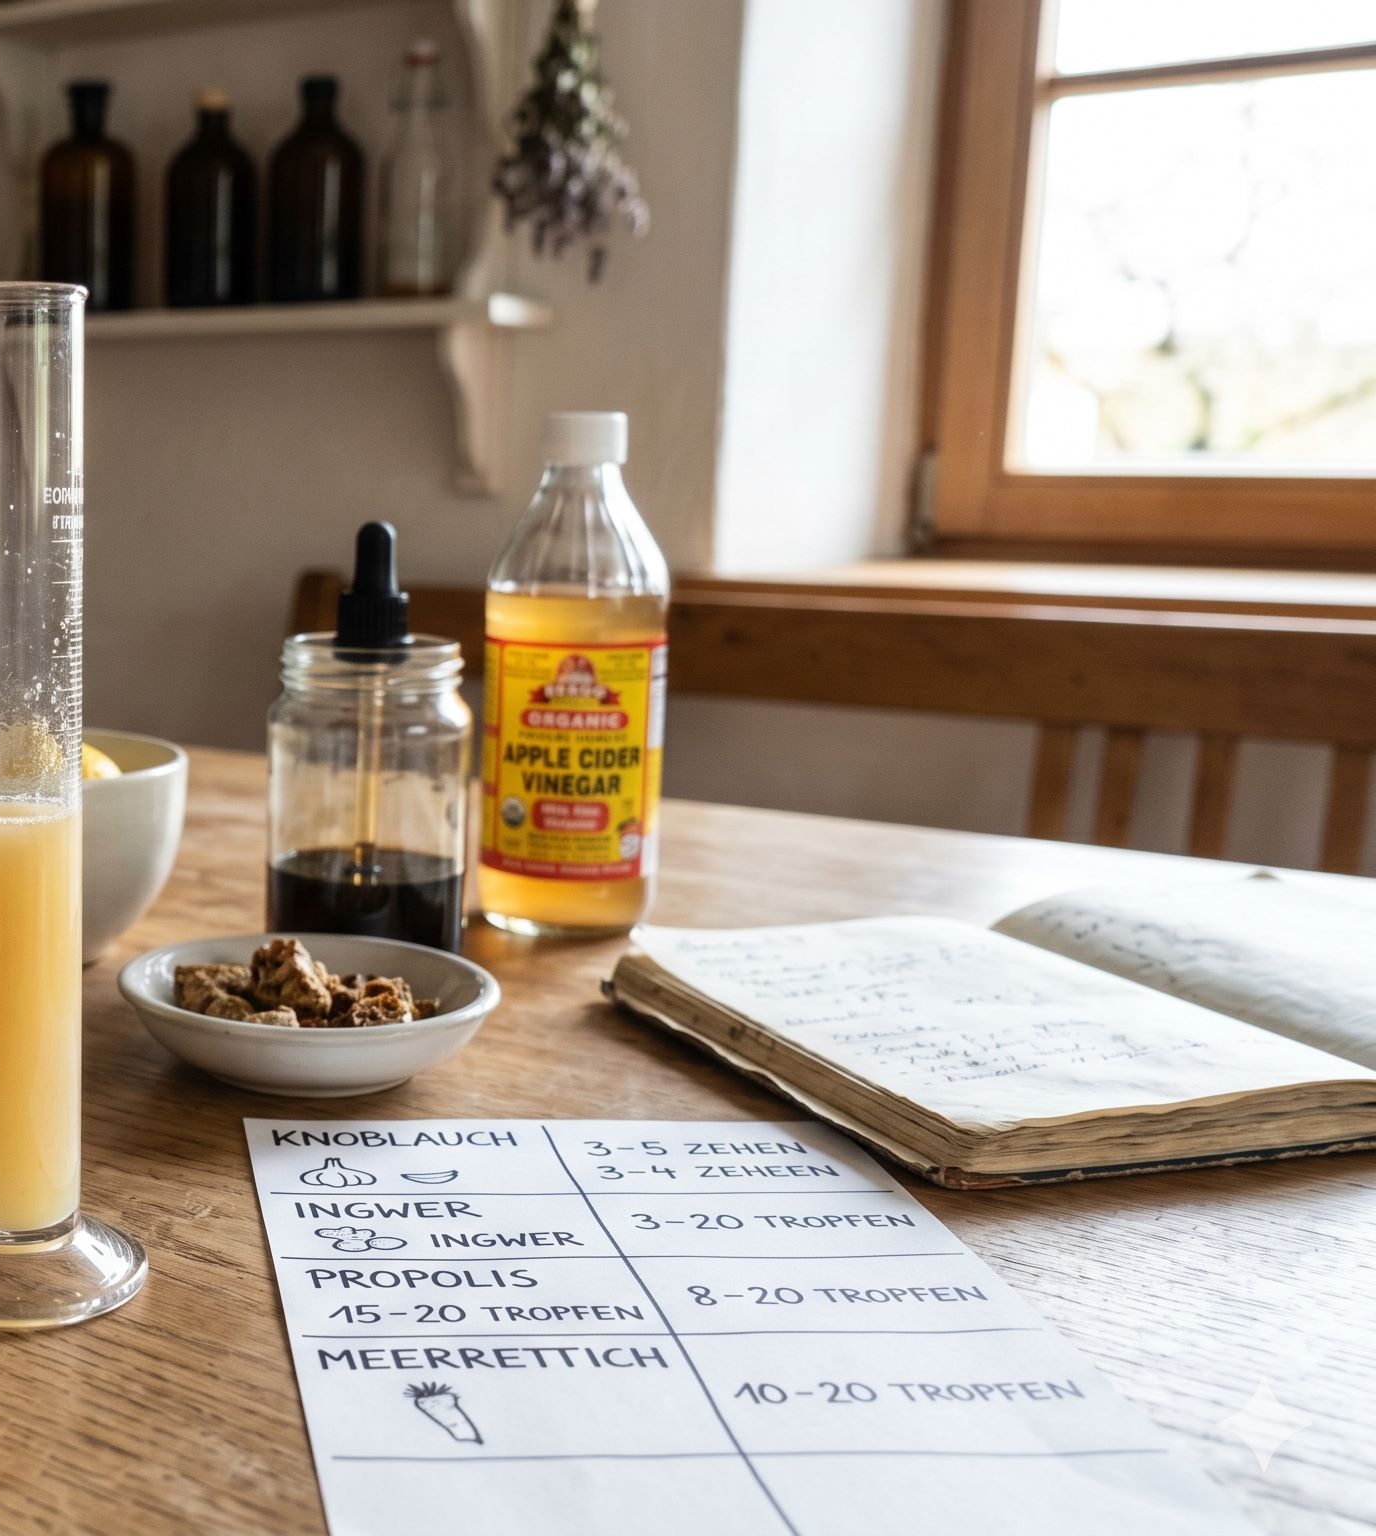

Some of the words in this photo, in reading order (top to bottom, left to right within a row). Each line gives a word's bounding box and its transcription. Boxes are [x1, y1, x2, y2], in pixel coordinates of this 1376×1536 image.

[527, 712, 622, 729] ORGANIC
[504, 745, 569, 769] APPLE
[579, 747, 640, 768] CIDER
[522, 772, 621, 795] VINEGAR
[270, 1128, 519, 1149] KNOBLAUCH
[582, 1139, 669, 1157] 3-5
[684, 1140, 809, 1157] ZEHEN
[596, 1163, 677, 1181] 3-4
[694, 1163, 841, 1179] ZEHEEN
[293, 1200, 484, 1221] INGWER
[630, 1212, 746, 1232] 3-20
[753, 1212, 917, 1230] TROPFEN
[429, 1230, 586, 1249] INGWER
[303, 1267, 540, 1291] PROPOLIS
[685, 1284, 806, 1308] 8-20
[813, 1284, 990, 1305] TROPFEN
[327, 1302, 468, 1326] 15-20
[480, 1304, 645, 1323] TROPFEN
[315, 1345, 671, 1372] MEERRETTICH
[732, 1379, 880, 1406] 10-20
[886, 1377, 1087, 1404] TROPFEN
